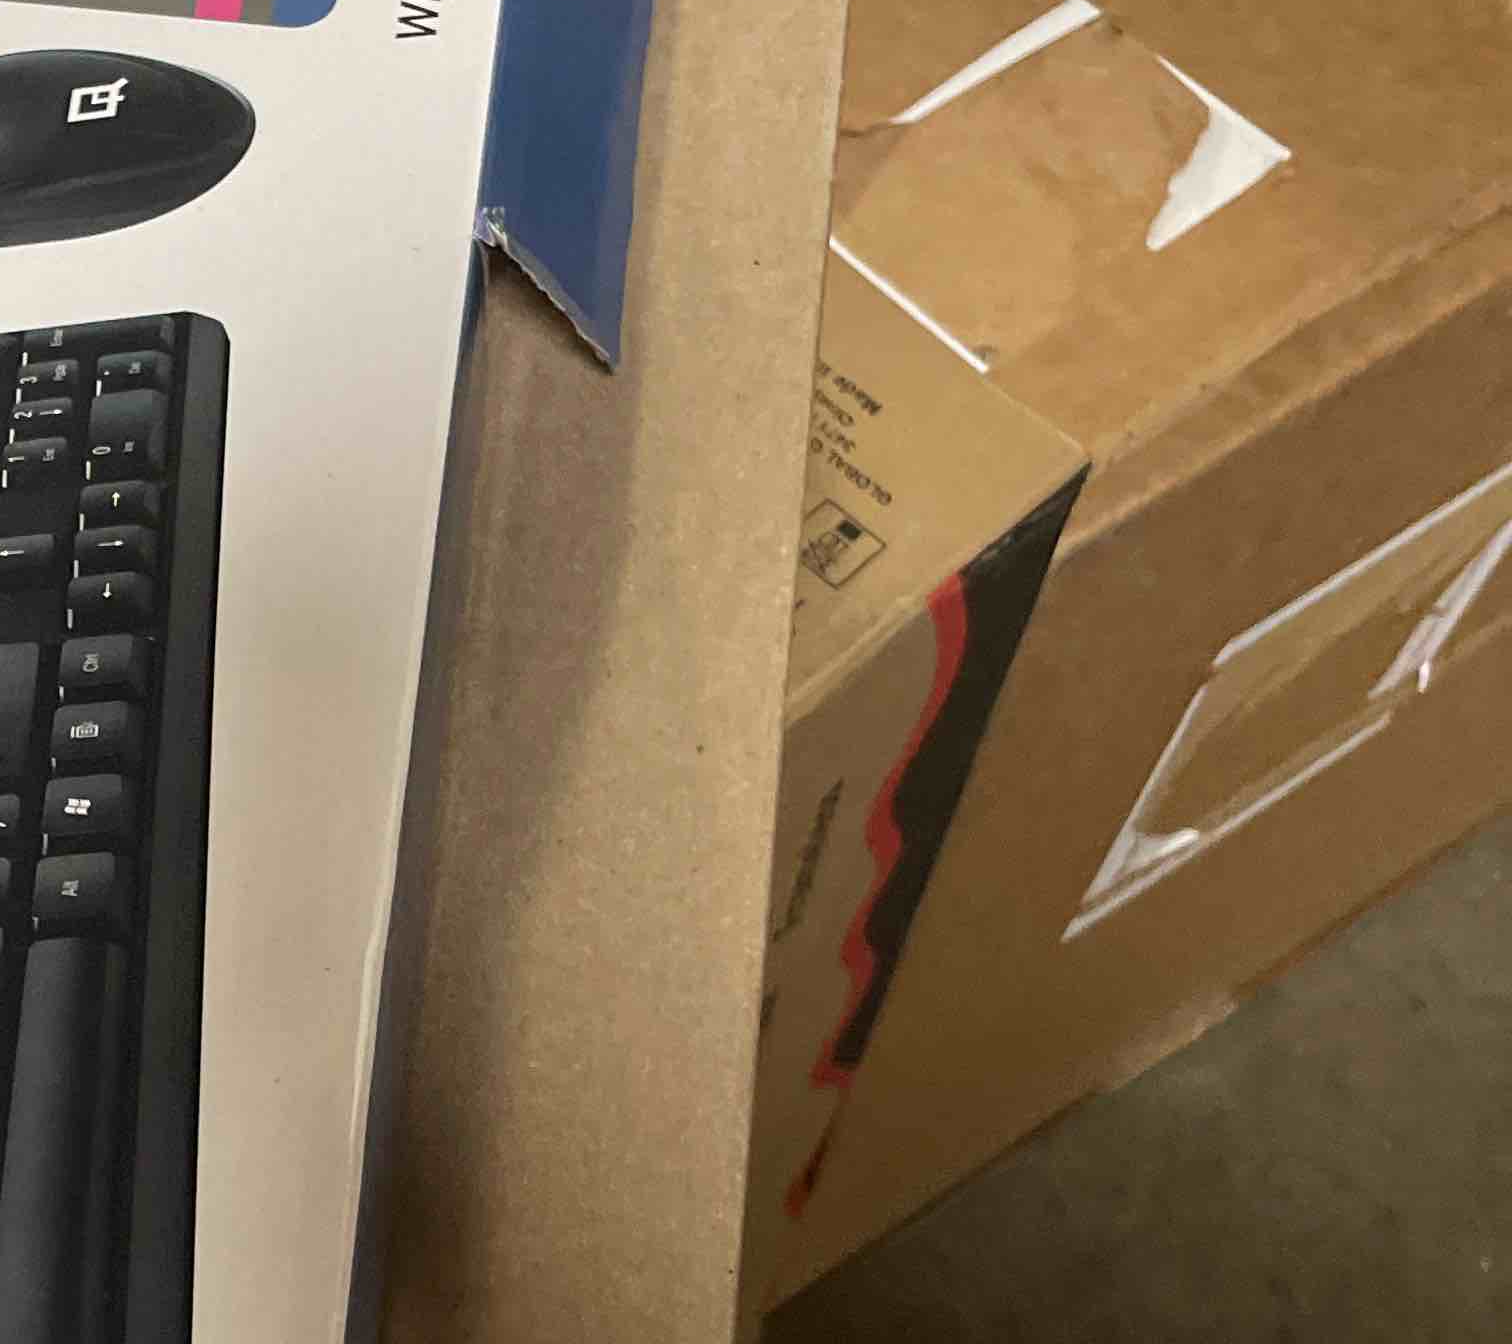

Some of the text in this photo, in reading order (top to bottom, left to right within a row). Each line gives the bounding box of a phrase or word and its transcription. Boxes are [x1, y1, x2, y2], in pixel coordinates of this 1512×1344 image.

[19, 375, 38, 385] 3
[13, 408, 33, 419] 2
[91, 445, 112, 456] 0
[7, 455, 25, 463] 1
